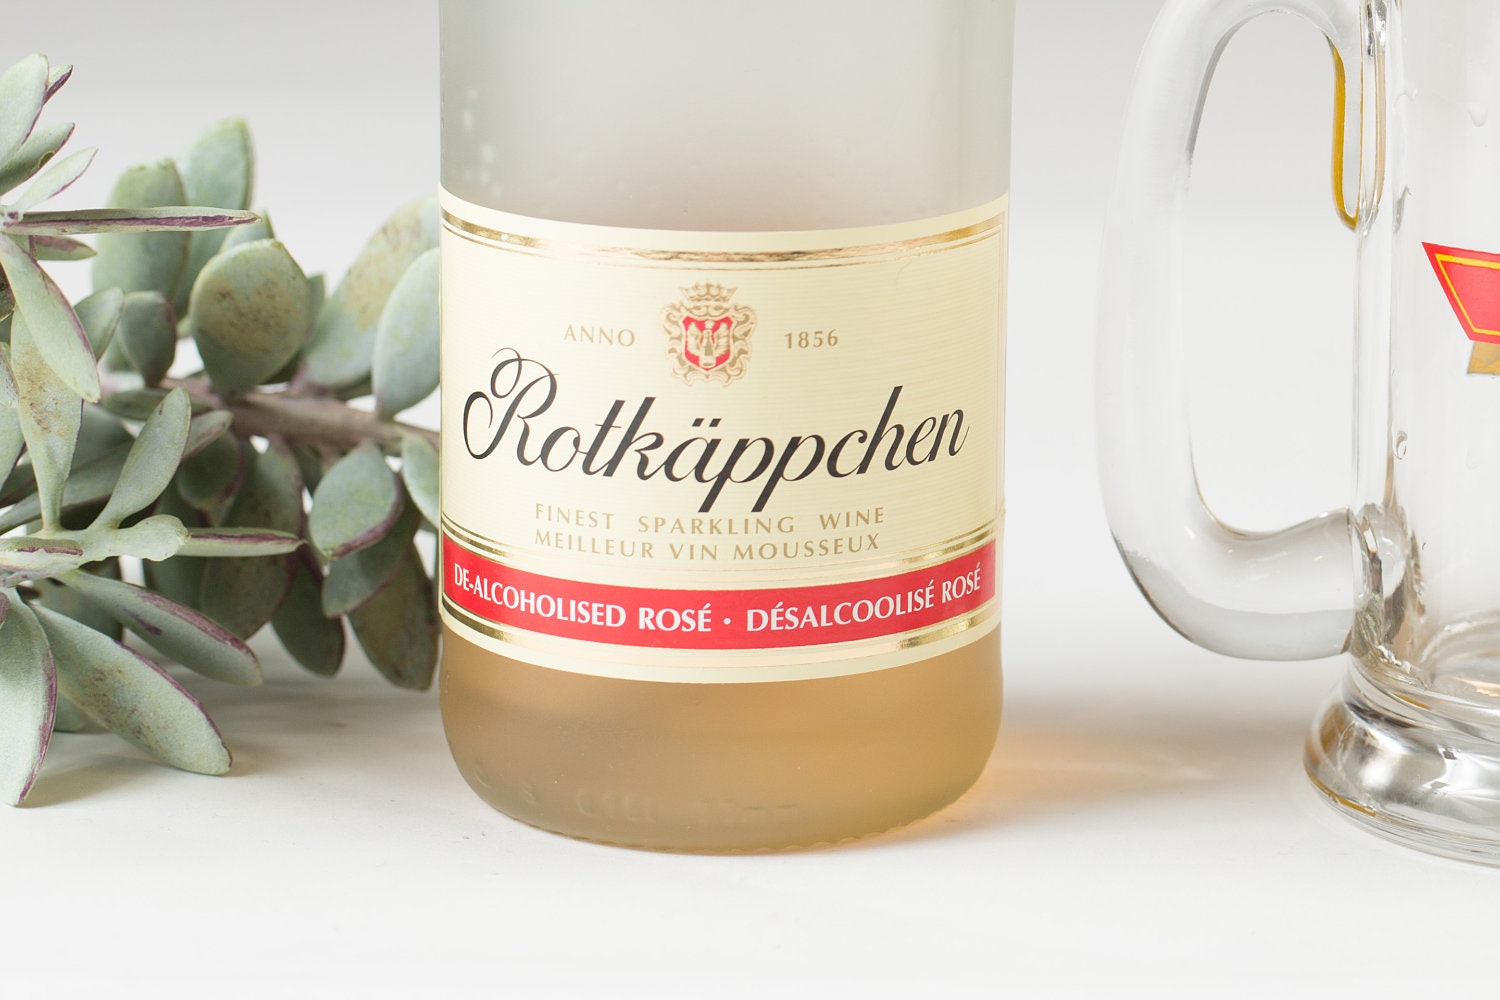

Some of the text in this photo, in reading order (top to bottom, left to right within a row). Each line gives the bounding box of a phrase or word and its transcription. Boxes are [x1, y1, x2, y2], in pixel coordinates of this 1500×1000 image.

[563, 323, 636, 348] ANNO
[784, 328, 840, 350] 1856
[462, 347, 970, 513] Rotkäppchen
[535, 503, 885, 535] FINEST SPARKLING WINE
[535, 528, 880, 560] MEILLEUR VIN MOUSSEUX
[453, 563, 982, 633] DE-ALCOHOLISED ROSÉ DÉSALCOOLISÉ ROSÉ
